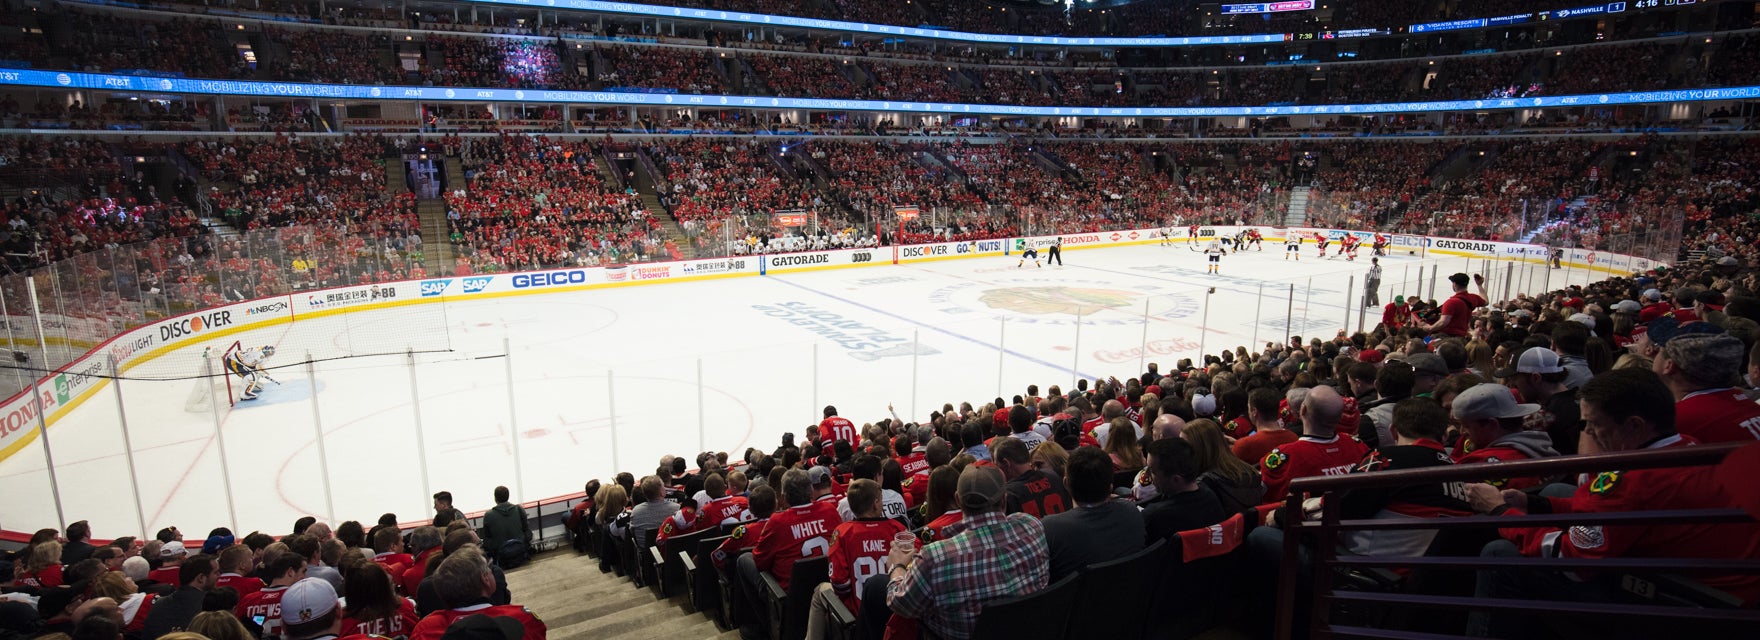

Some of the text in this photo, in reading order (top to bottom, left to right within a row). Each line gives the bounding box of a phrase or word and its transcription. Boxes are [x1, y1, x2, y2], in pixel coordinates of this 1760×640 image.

[613, 3, 633, 12] YOUR
[1571, 6, 1604, 15] NASHVILLE
[105, 77, 130, 87] AT&T
[201, 81, 270, 93] MOBILIZING
[270, 84, 303, 95] YOUR
[404, 89, 423, 97] AT&T
[543, 92, 592, 101] MOBILIZING
[593, 93, 616, 101] YOUR
[1629, 90, 1687, 102] MOBILIZING
[1688, 88, 1719, 99] YOUR
[1407, 102, 1428, 111] YOUR
[956, 241, 969, 254] GO
[978, 239, 1001, 252] NUTS!
[1063, 235, 1101, 245] HONDA
[1436, 239, 1496, 253] GATORADE
[903, 245, 948, 258] DISCOVER
[1507, 247, 1550, 256] UNTED
[735, 260, 745, 270] 88
[771, 253, 829, 267] GATORADE
[512, 270, 586, 289] GEICO
[641, 271, 670, 279] DONUTS
[421, 281, 447, 295] SAP
[463, 278, 488, 291] SAP
[381, 287, 396, 298] 88
[255, 302, 288, 314] NBCSN
[160, 310, 233, 342] DISCOVER
[775, 301, 908, 344] PLAYOFFS
[780, 317, 881, 350] STANLEY
[131, 334, 154, 353] LIGHT
[1092, 336, 1200, 364] Coca-Cola
[56, 361, 102, 397] enterprise
[832, 424, 854, 447] 10
[902, 458, 930, 473] SEABROO
[1321, 463, 1356, 477] TOEW
[721, 503, 742, 518] KANE
[882, 501, 906, 515] FORD
[790, 518, 828, 541] WHITE
[862, 539, 887, 553] KANE
[247, 602, 281, 618] TOEWS
